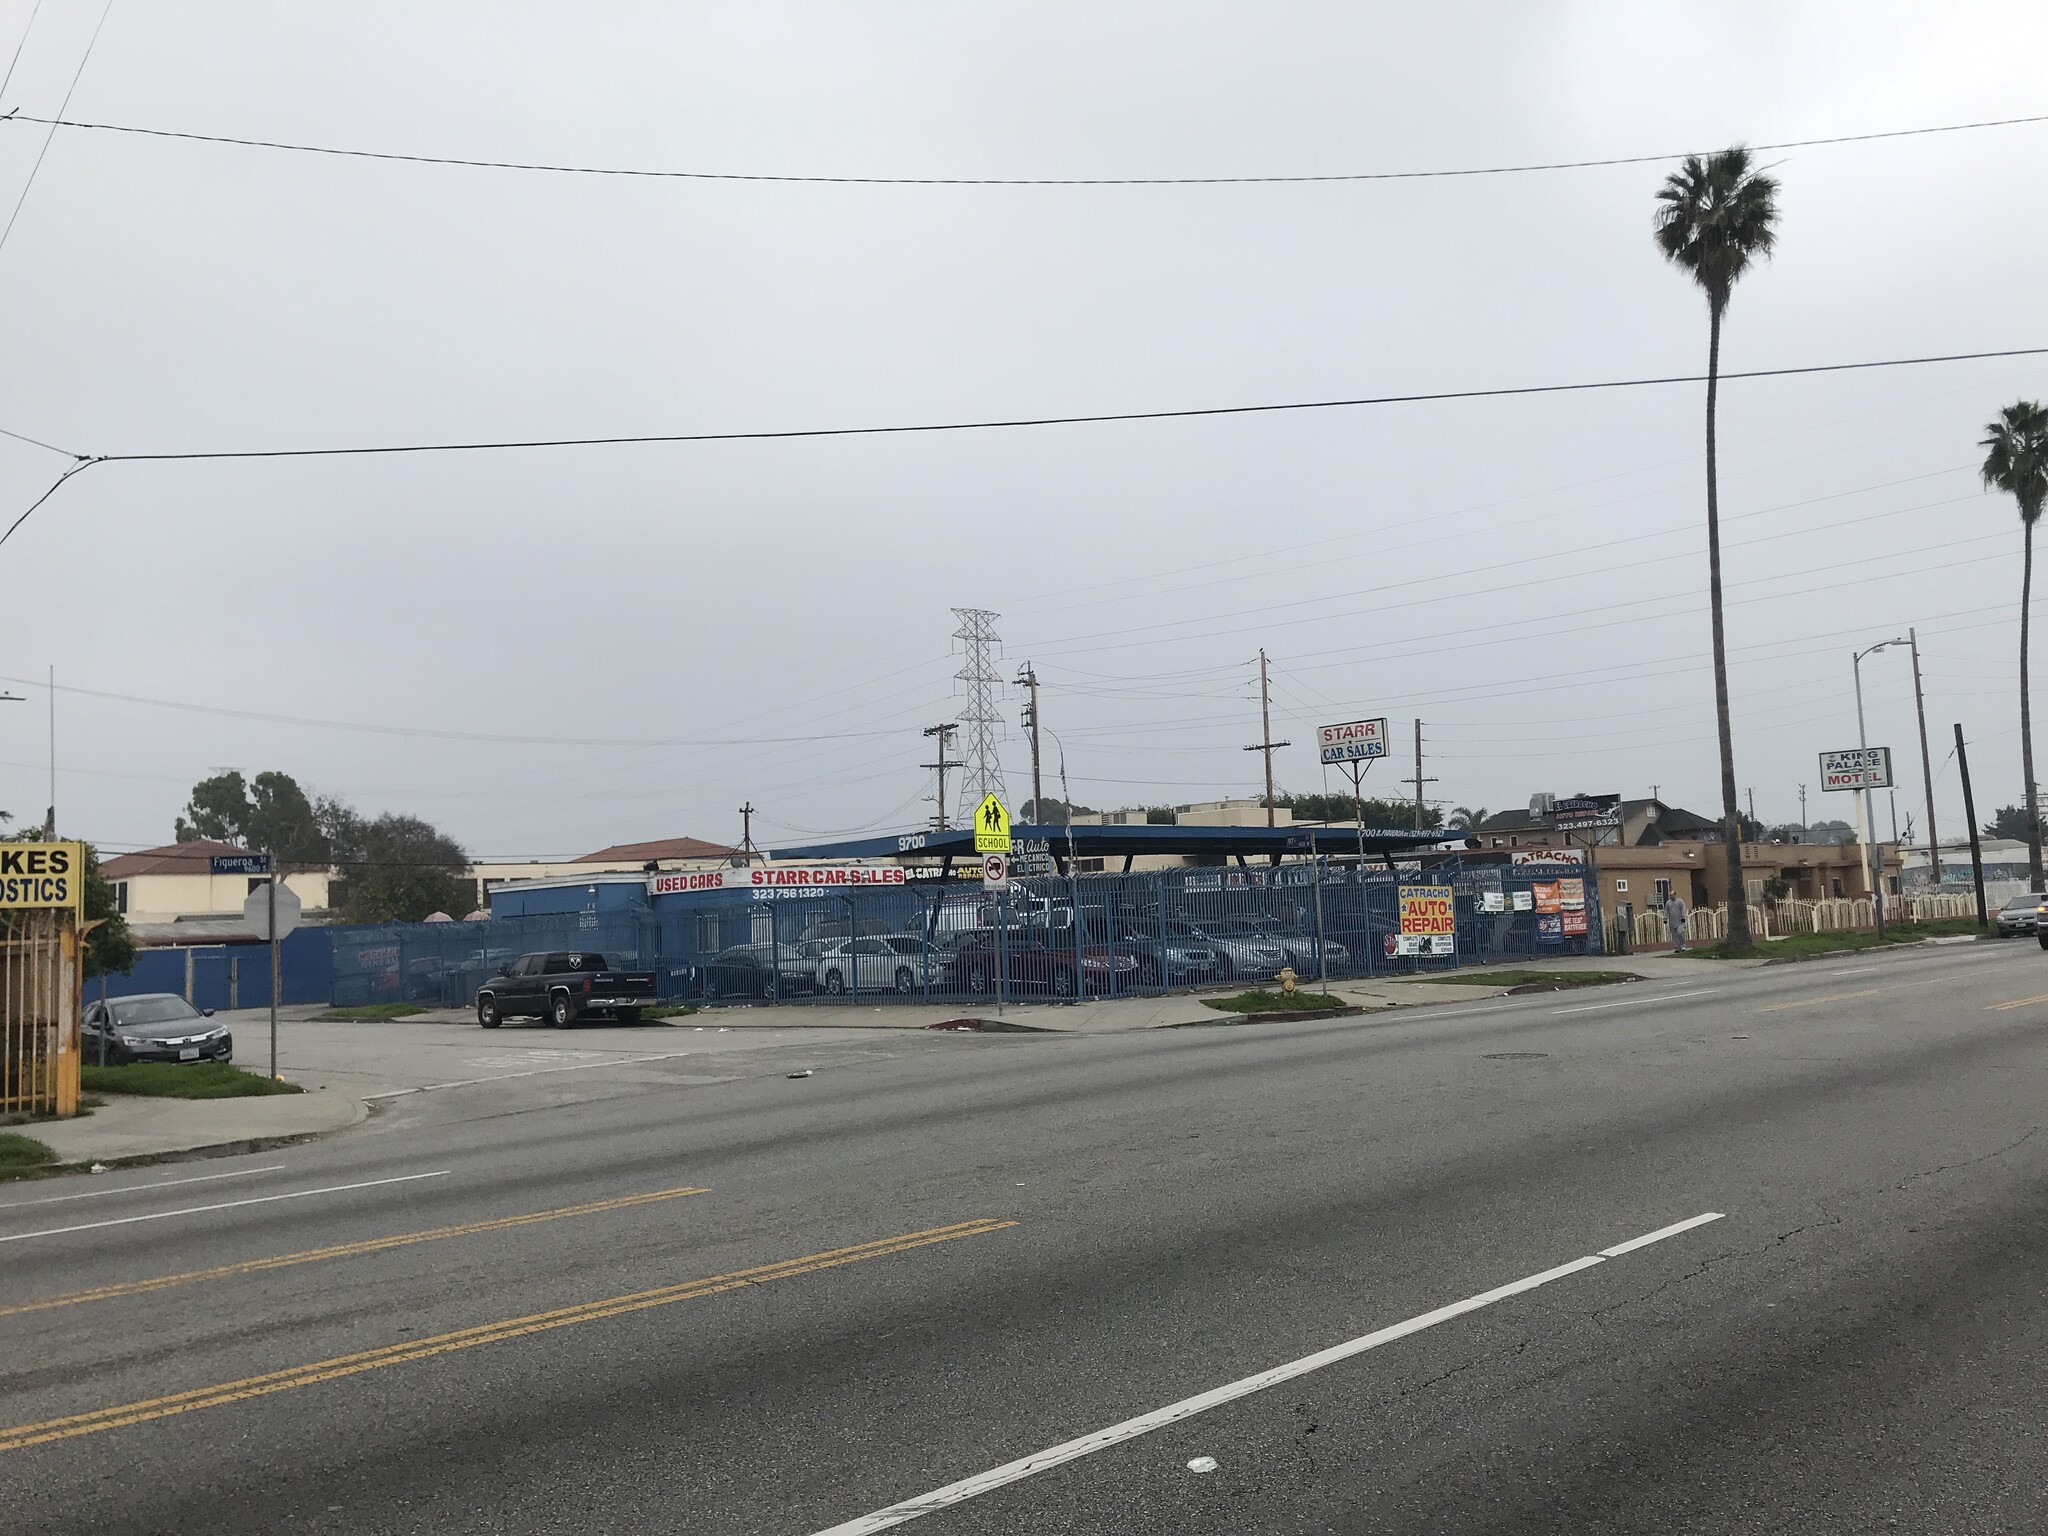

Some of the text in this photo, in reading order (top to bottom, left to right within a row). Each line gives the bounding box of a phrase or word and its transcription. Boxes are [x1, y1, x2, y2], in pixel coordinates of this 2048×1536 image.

[1324, 724, 1375, 741] STARR
[1324, 742, 1382, 760] CAR SALES
[1557, 818, 1619, 830] 323.497-6323
[898, 835, 925, 851] 9700
[978, 838, 1008, 849] SCHOOL
[1026, 836, 1050, 853] Auto
[214, 857, 253, 869] Figueroa
[751, 869, 904, 885] STARR CAR SALES
[905, 869, 916, 880] EL
[656, 873, 723, 892] USED CARS
[752, 888, 824, 900] 323 756 1320
[1400, 888, 1450, 898] CATRACHO
[1408, 901, 1447, 916] AUTO
[1402, 918, 1454, 932] REPAIR
